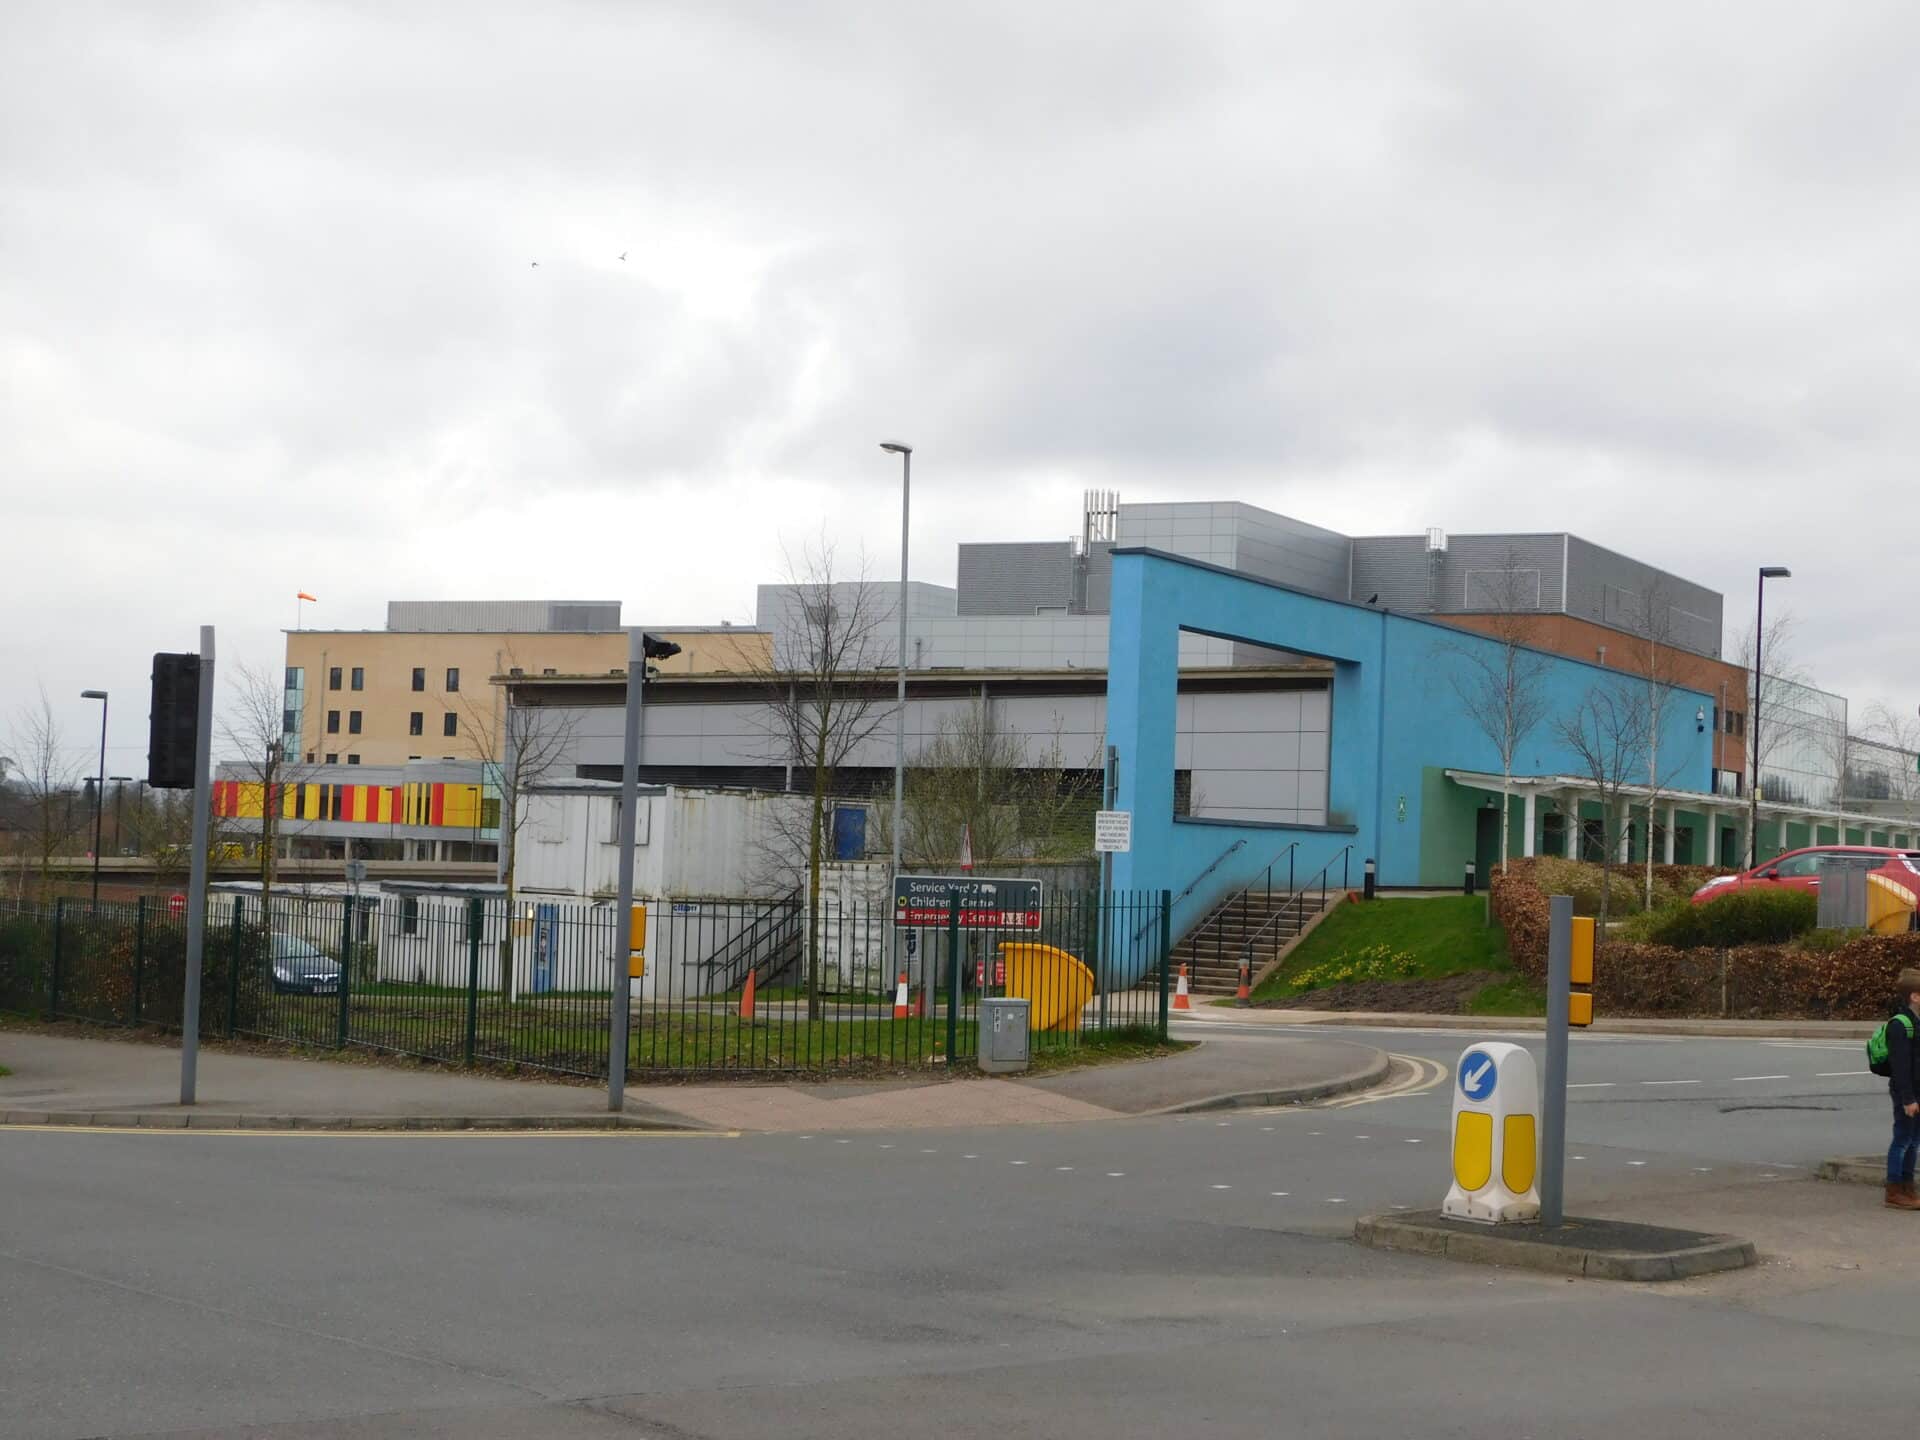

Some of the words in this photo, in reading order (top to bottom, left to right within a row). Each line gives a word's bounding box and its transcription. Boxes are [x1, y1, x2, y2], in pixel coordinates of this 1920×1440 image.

[910, 882, 945, 893] Service
[948, 883, 970, 894] Yard
[972, 884, 978, 894] 2
[910, 912, 962, 924] Emergey
